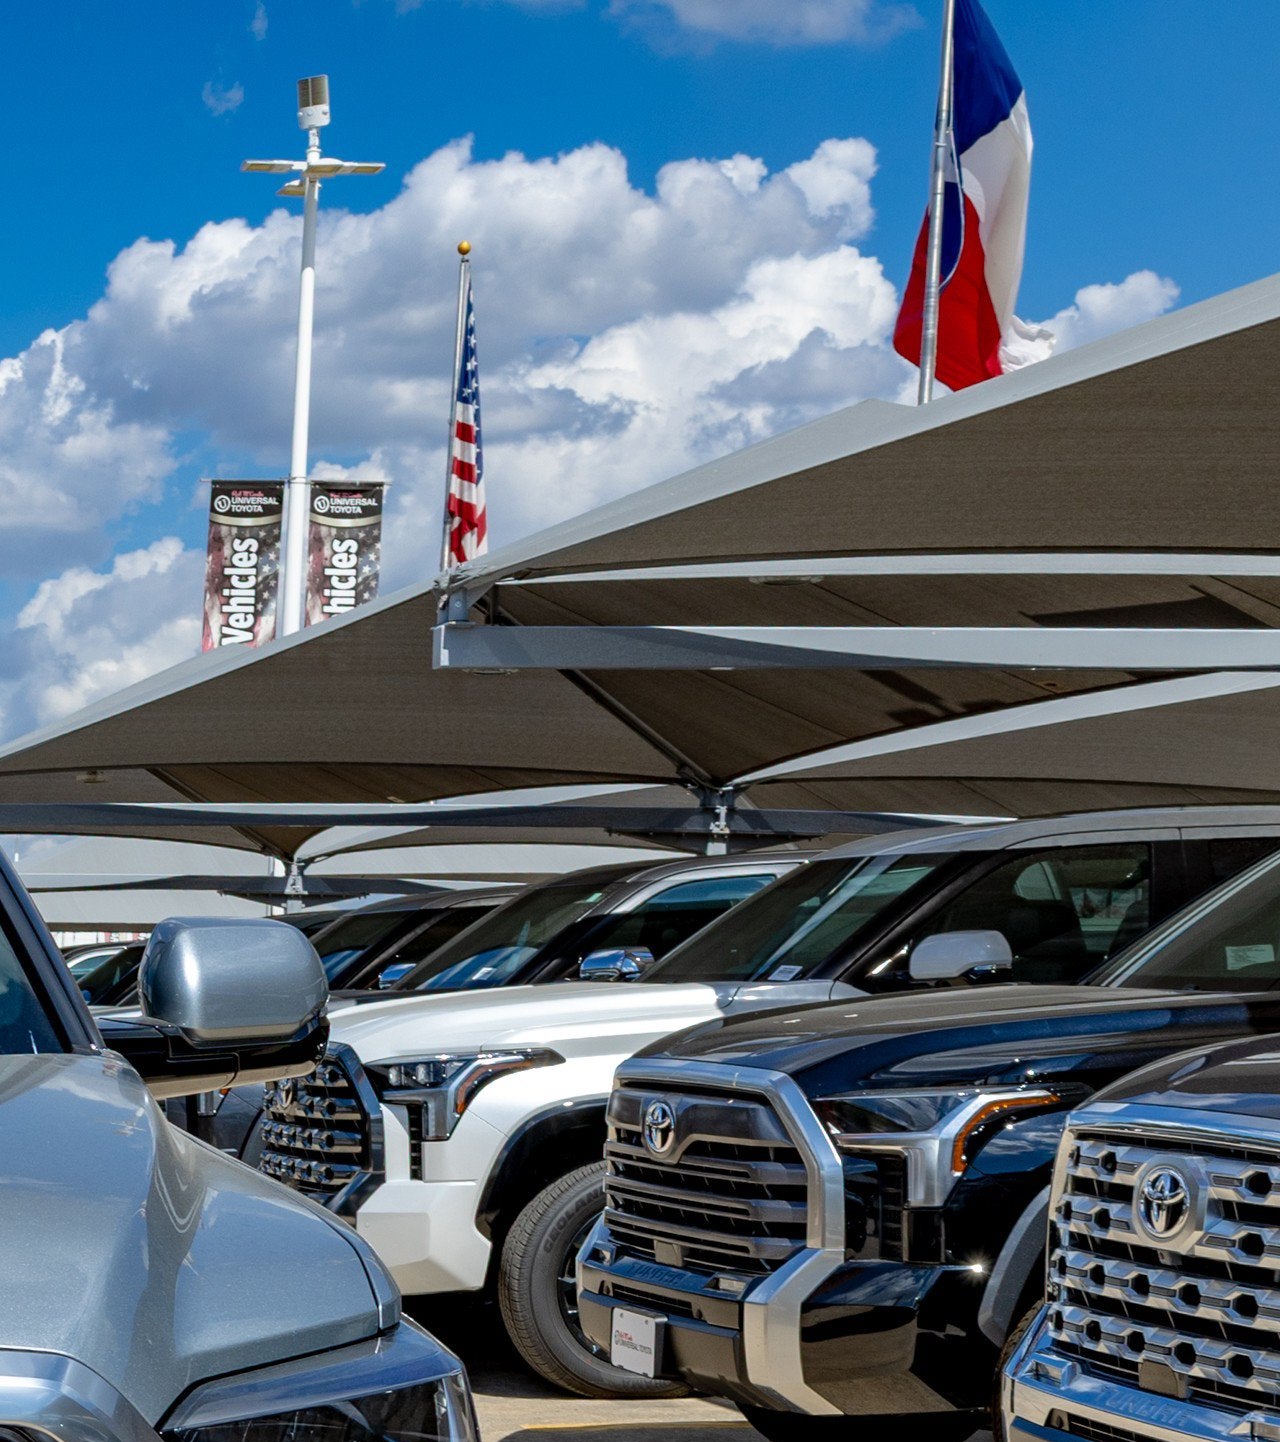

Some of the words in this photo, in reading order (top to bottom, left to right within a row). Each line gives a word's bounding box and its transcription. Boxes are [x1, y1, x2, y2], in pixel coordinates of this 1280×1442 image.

[231, 496, 280, 505] UNIVERSAL
[330, 497, 378, 506] UNIVERSAL
[230, 504, 264, 513] TOYOTA
[329, 505, 363, 514] TOYOTA
[323, 539, 359, 617] hicles
[221, 538, 259, 646] Vehicles
[1095, 1386, 1192, 1426] TUNDRA
